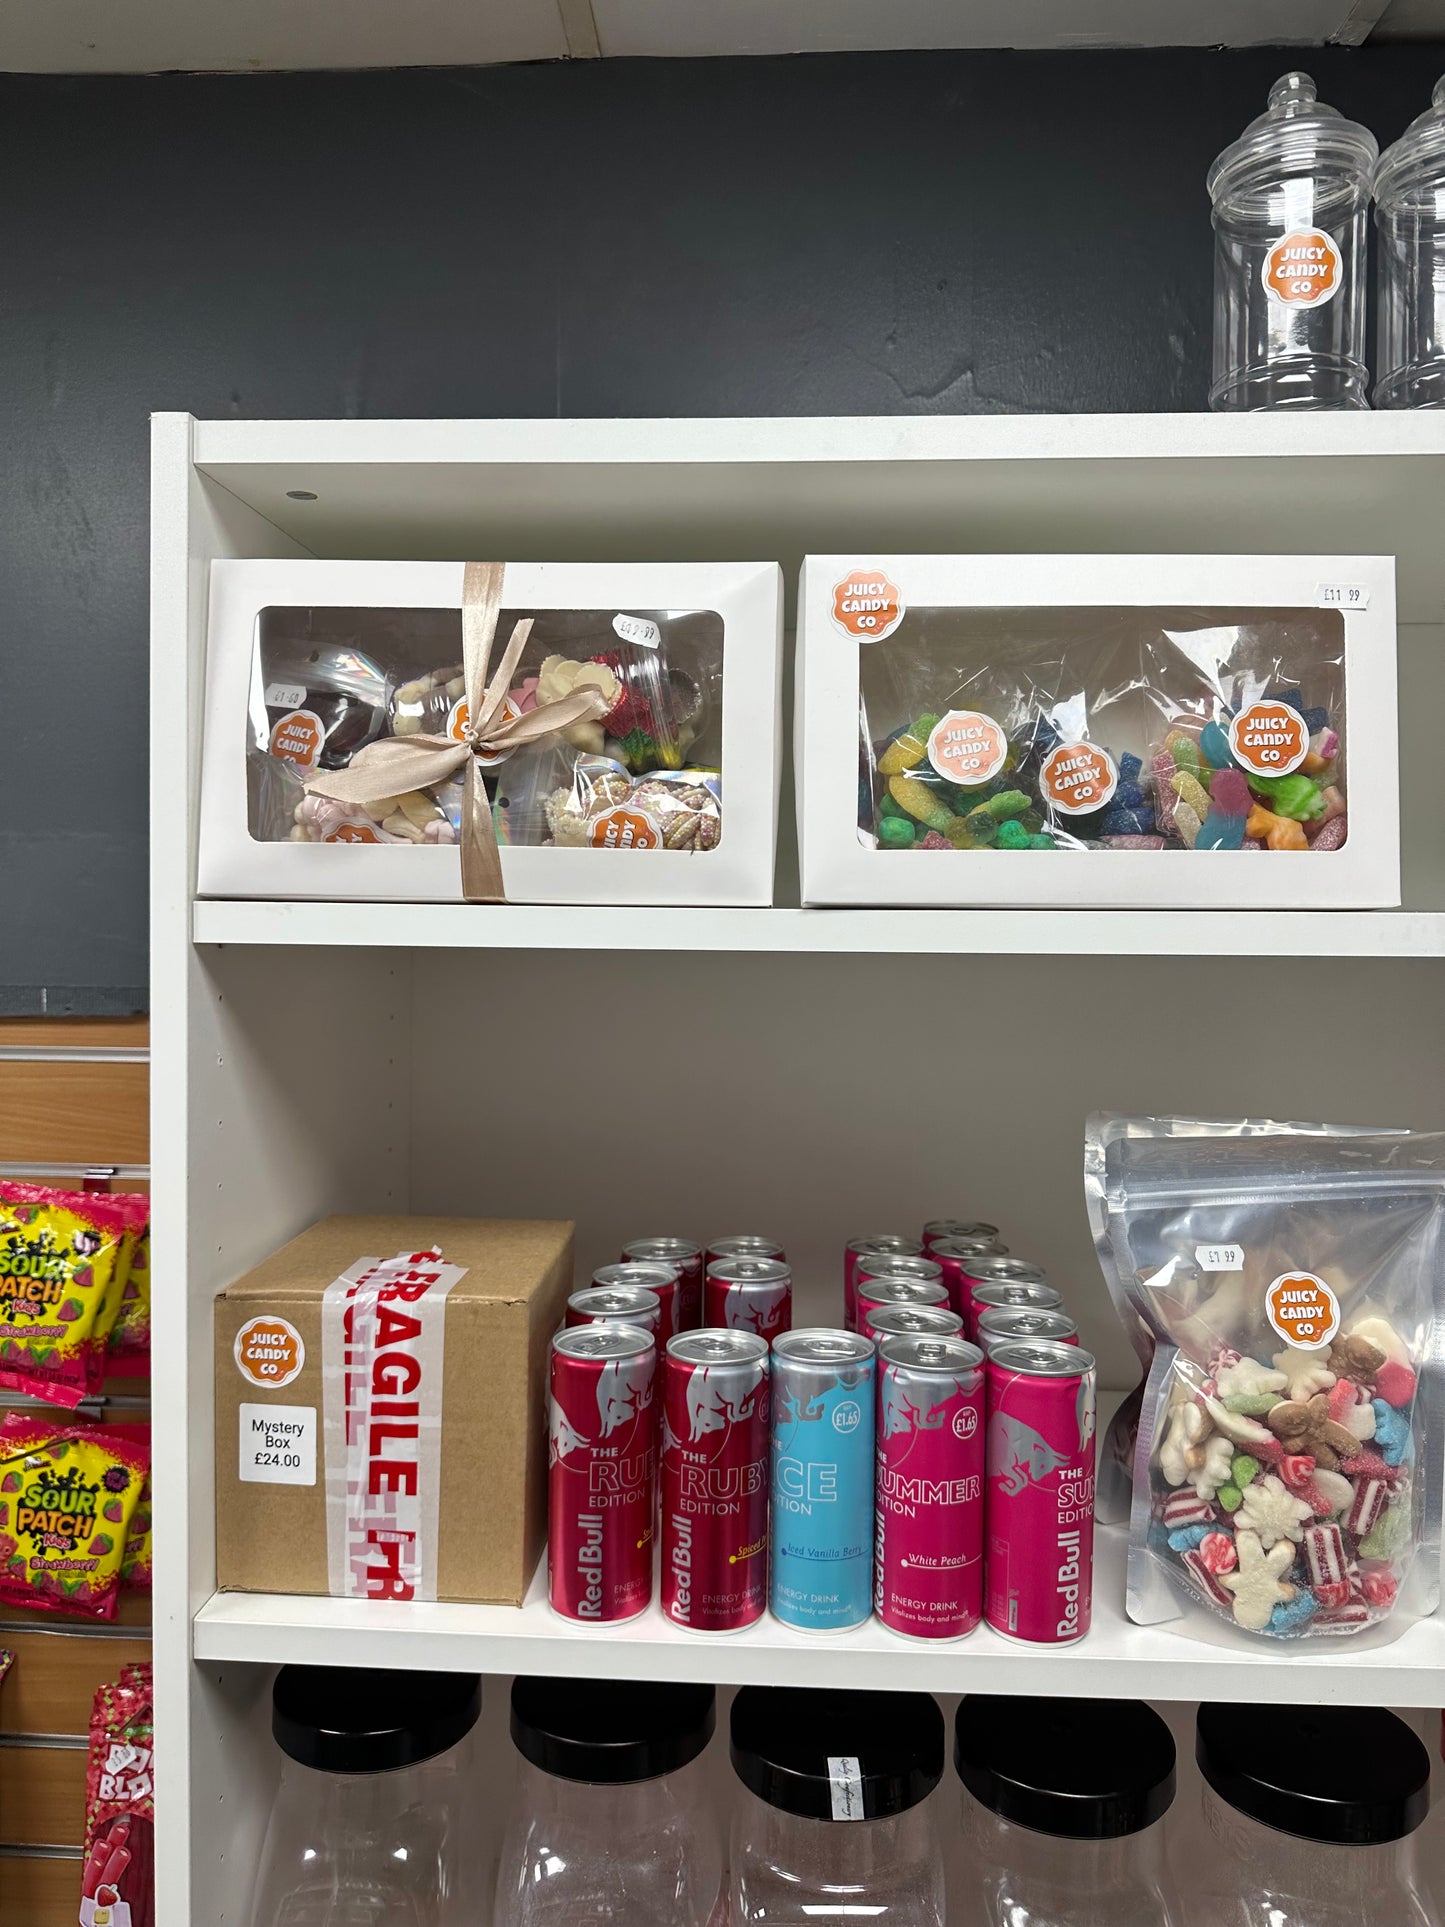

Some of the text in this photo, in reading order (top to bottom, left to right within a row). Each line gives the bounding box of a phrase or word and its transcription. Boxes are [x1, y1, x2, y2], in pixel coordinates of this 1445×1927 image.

[1281, 246, 1326, 262] JUICY
[1276, 264, 1328, 279] CANDY
[1290, 280, 1312, 294] CO
[844, 583, 887, 597] JUICY
[1324, 588, 1341, 601] £11
[841, 599, 891, 613] CANDY
[857, 615, 876, 628] CO
[1246, 717, 1289, 731] JUICY
[282, 724, 314, 740] JUICY
[944, 725, 984, 744] JUICY
[276, 737, 311, 755] CANDY
[1243, 733, 1294, 747] CANDY
[943, 740, 991, 759] CANDY
[1260, 749, 1281, 762] CO
[961, 757, 980, 771] CO
[1054, 753, 1093, 776] JUICY
[1054, 767, 1101, 791] CANDY
[1074, 786, 1093, 800] CO
[637, 837, 649, 848] O
[1279, 1290, 1318, 1304] JUICY
[1279, 1306, 1325, 1320] CANDY
[1296, 1323, 1315, 1336] CO
[250, 1333, 288, 1346] JUICY
[246, 1347, 291, 1361] CANDY
[259, 1363, 279, 1375] CO
[368, 1270, 442, 1497] FRAGILE
[835, 1411, 858, 1427] £1.65
[956, 1416, 976, 1433] £1.65
[252, 1418, 305, 1438] Mystery
[265, 1435, 291, 1449] Box
[254, 1452, 301, 1468] £24.00
[590, 1447, 619, 1458] THE
[681, 1450, 707, 1464] THE
[1058, 1467, 1083, 1480] THE
[25, 1483, 96, 1516] SOUR
[589, 1488, 646, 1508] EDITION
[877, 1491, 916, 1518] DITION
[680, 1498, 741, 1515] EDITION
[17, 1507, 95, 1539] PATCH
[788, 1543, 805, 1556] Iced
[808, 1546, 840, 1559] Vanilla
[30, 1556, 100, 1571] Strawberry
[577, 1513, 604, 1617] Red Bull
[909, 1553, 967, 1566] White Peach
[671, 1513, 693, 1622] Red Bull
[1056, 1530, 1081, 1637] Red Bull
[702, 1593, 740, 1604] ENERGY
[777, 1583, 840, 1604] ENERGY DRINK
[891, 1593, 958, 1611] ENERGY DRINK
[918, 1613, 935, 1624] body
